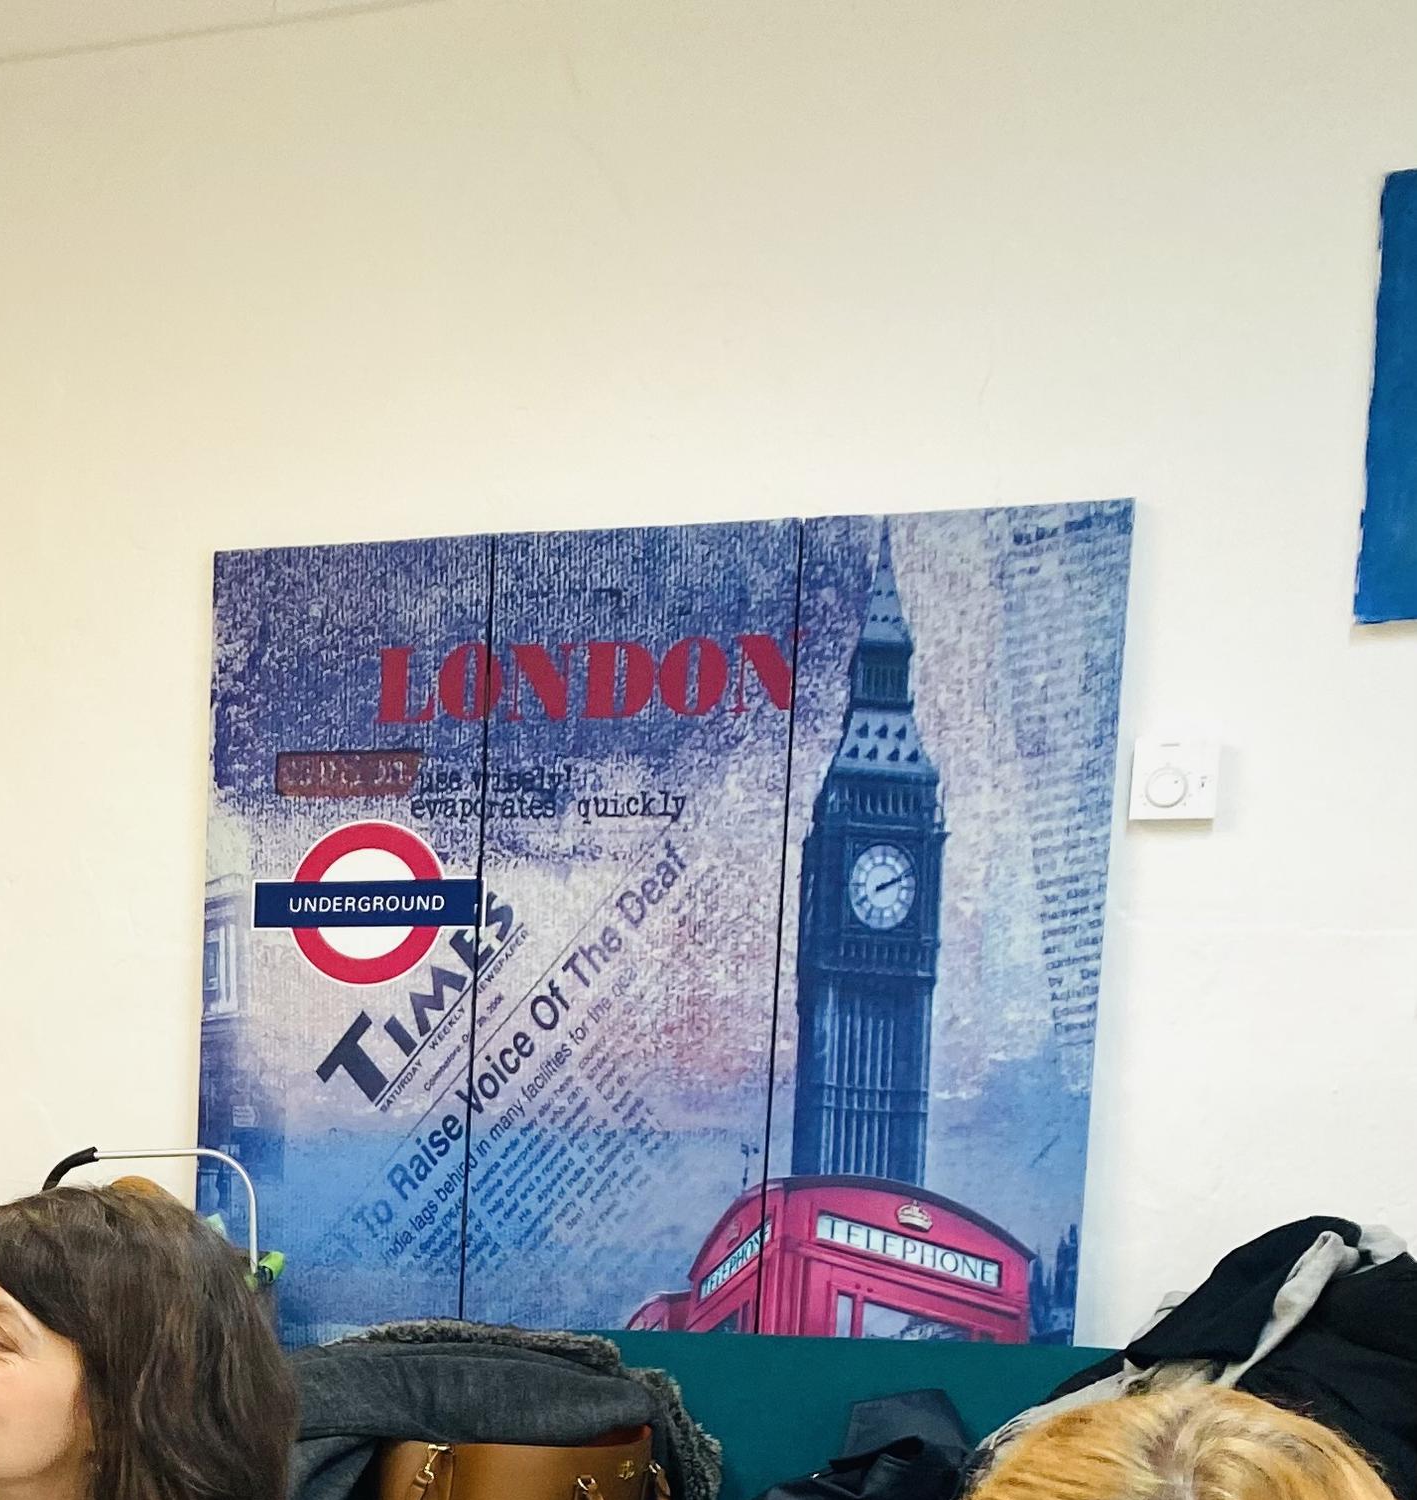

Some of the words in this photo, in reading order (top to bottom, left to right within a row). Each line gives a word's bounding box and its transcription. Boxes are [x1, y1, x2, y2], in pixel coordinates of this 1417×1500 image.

[375, 630, 798, 724] LONDON
[410, 796, 556, 820] evaporates
[577, 790, 688, 824] quickly
[288, 894, 446, 913] UNDERGROUND
[316, 891, 514, 1102] TIMES
[386, 1111, 464, 1201] Raise
[455, 1031, 535, 1116] Voice
[530, 979, 571, 1031] Of
[562, 925, 623, 988] The
[616, 846, 687, 925] Deaf
[380, 1059, 424, 1112] SATURDAY
[429, 1007, 465, 1050] WEEKLY
[412, 1200, 439, 1232] lags
[436, 1156, 479, 1204] behind
[490, 1098, 527, 1141] many
[521, 1043, 573, 1103] facilities
[828, 1217, 1001, 1285] TELEPHONE
